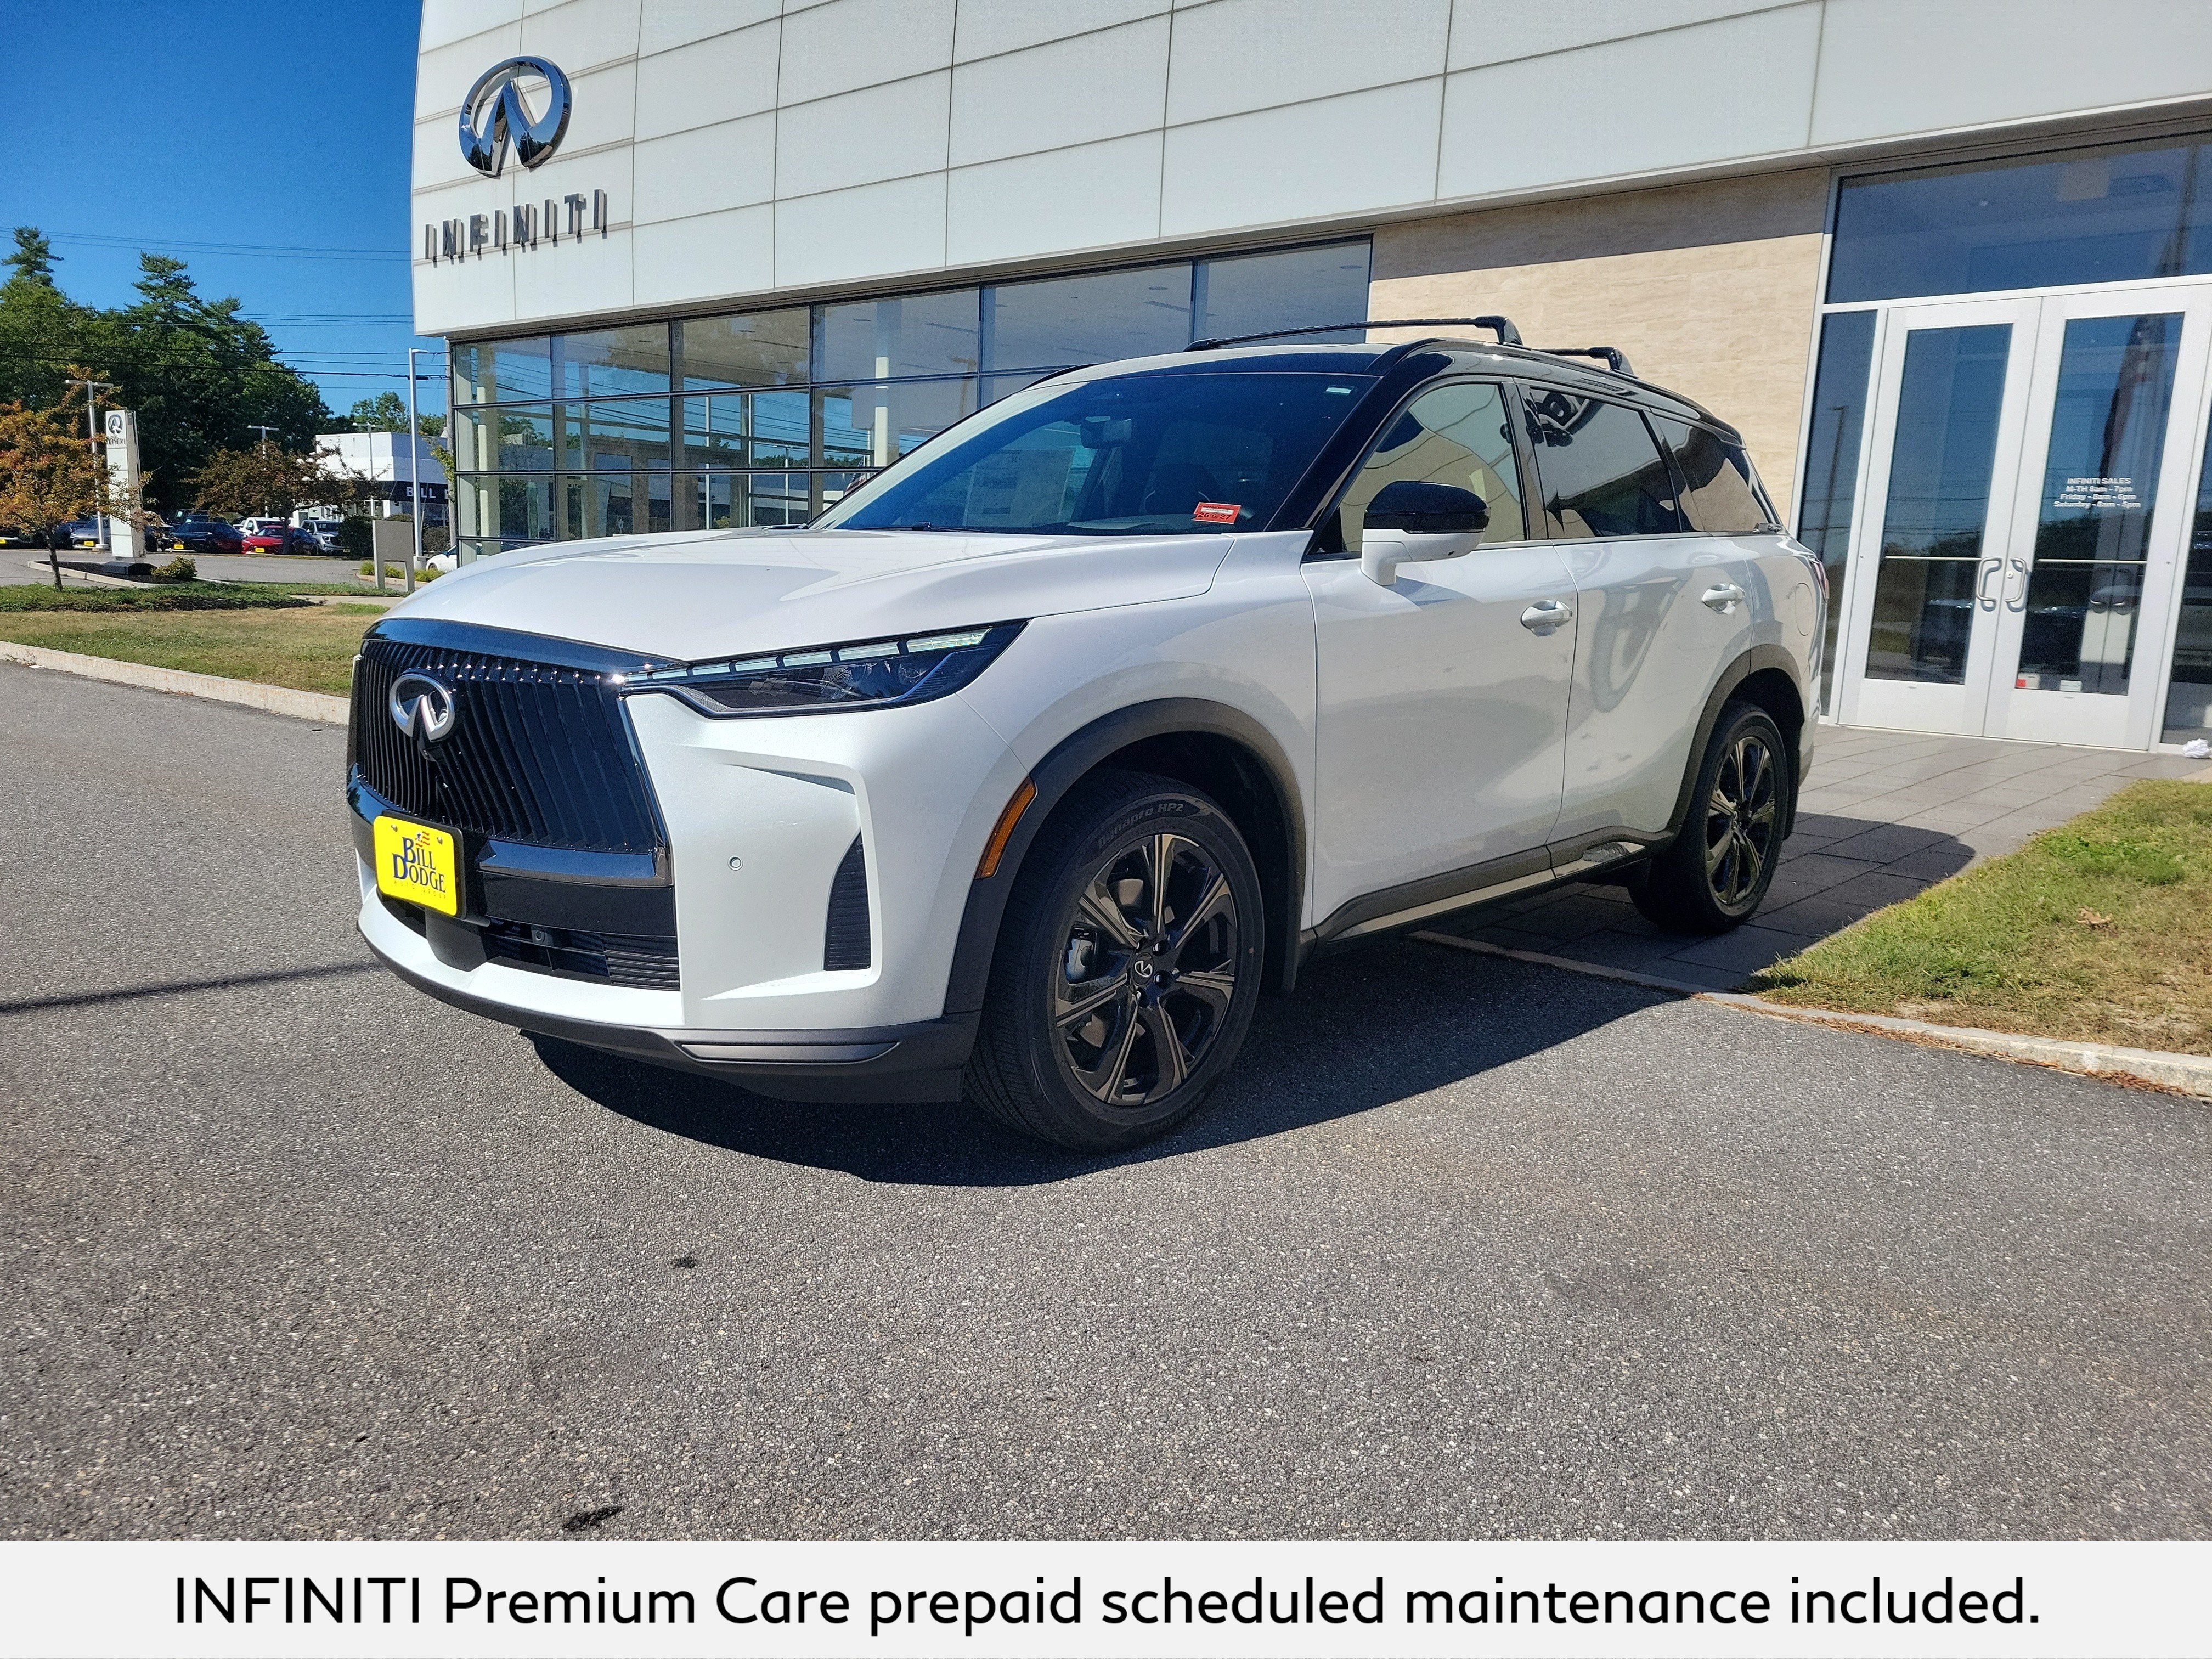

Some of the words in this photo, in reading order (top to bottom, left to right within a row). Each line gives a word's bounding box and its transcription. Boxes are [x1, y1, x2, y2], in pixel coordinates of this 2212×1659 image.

[425, 189, 606, 261] INFINITI
[407, 487, 436, 498] BLL
[1098, 808, 1153, 848] Dynapro
[1158, 803, 1184, 813] HP2
[392, 853, 446, 893] DODGE
[402, 837, 436, 870] BILL
